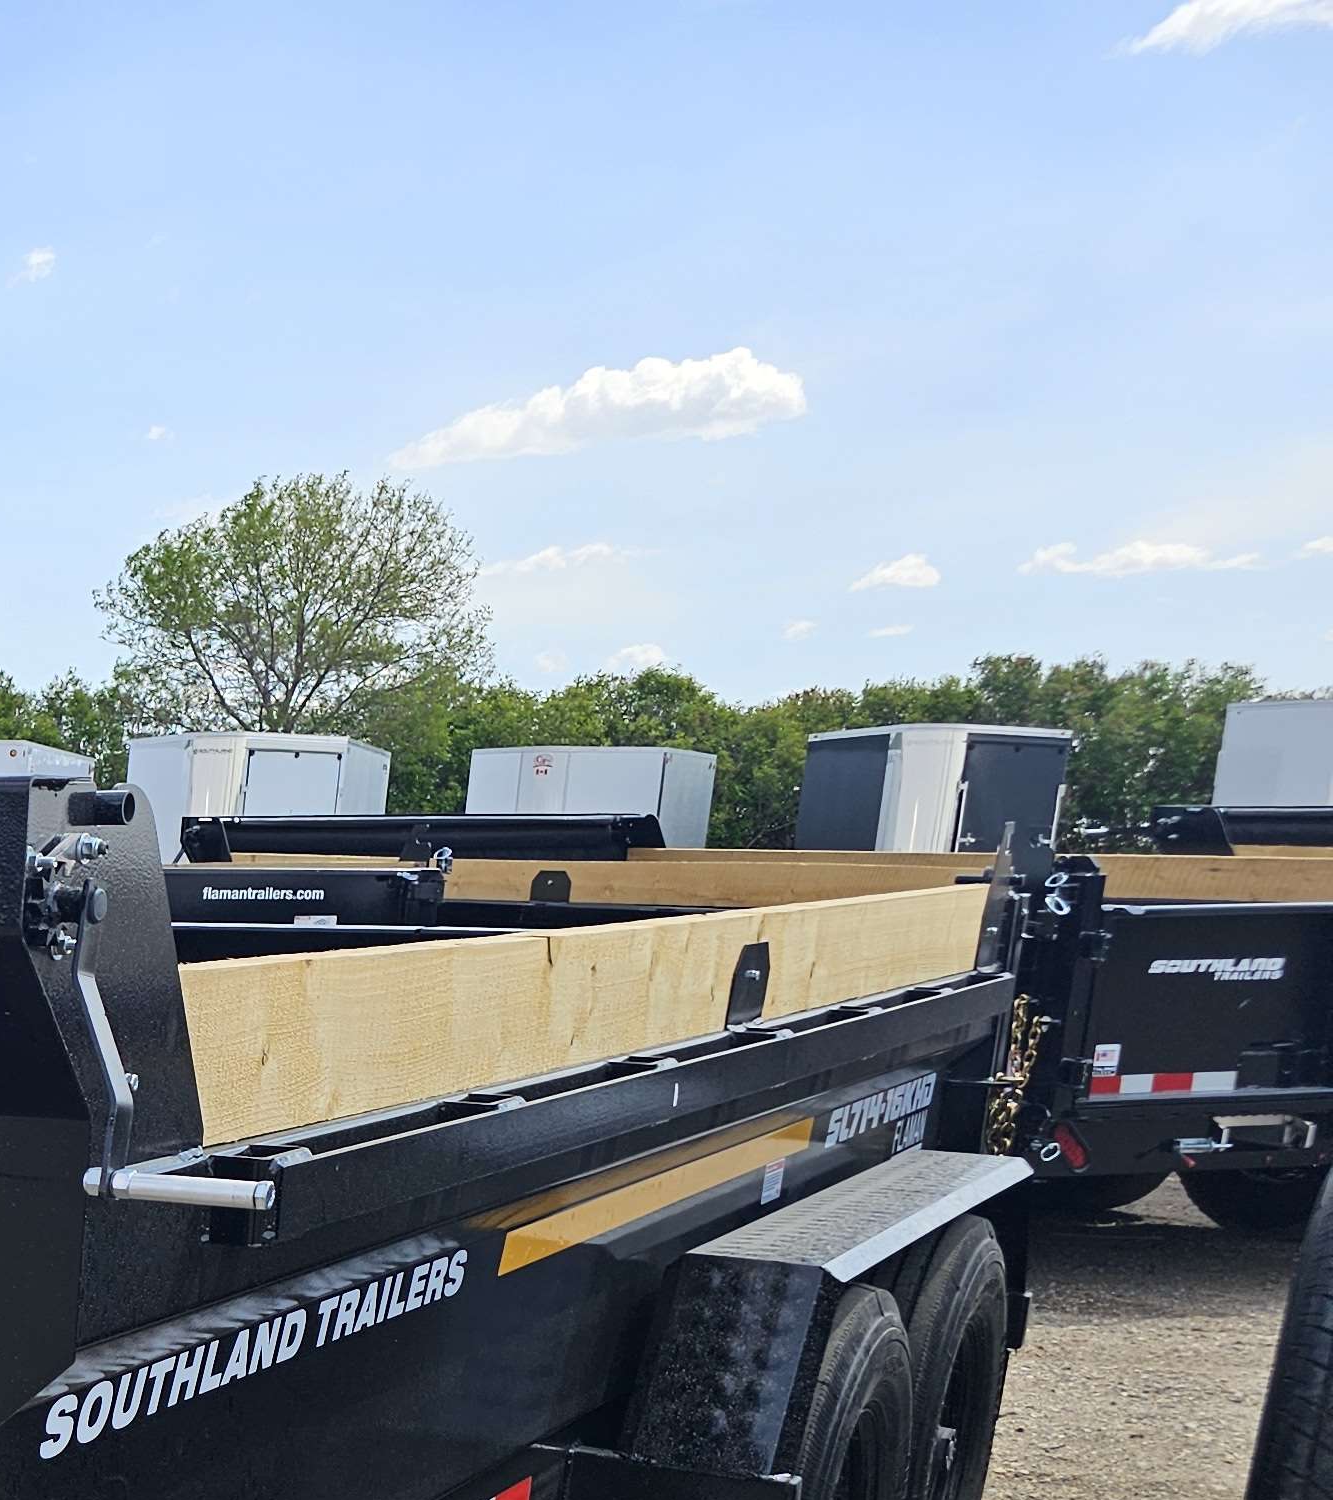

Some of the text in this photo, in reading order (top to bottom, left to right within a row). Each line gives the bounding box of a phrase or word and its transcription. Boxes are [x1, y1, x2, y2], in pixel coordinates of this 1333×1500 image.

[202, 886, 325, 901] flamantrailers.com
[1148, 957, 1286, 974] SOUTHLAND
[1213, 970, 1285, 981] TRAILERS
[39, 1249, 468, 1460] SOUTHLAND TRAILERS
